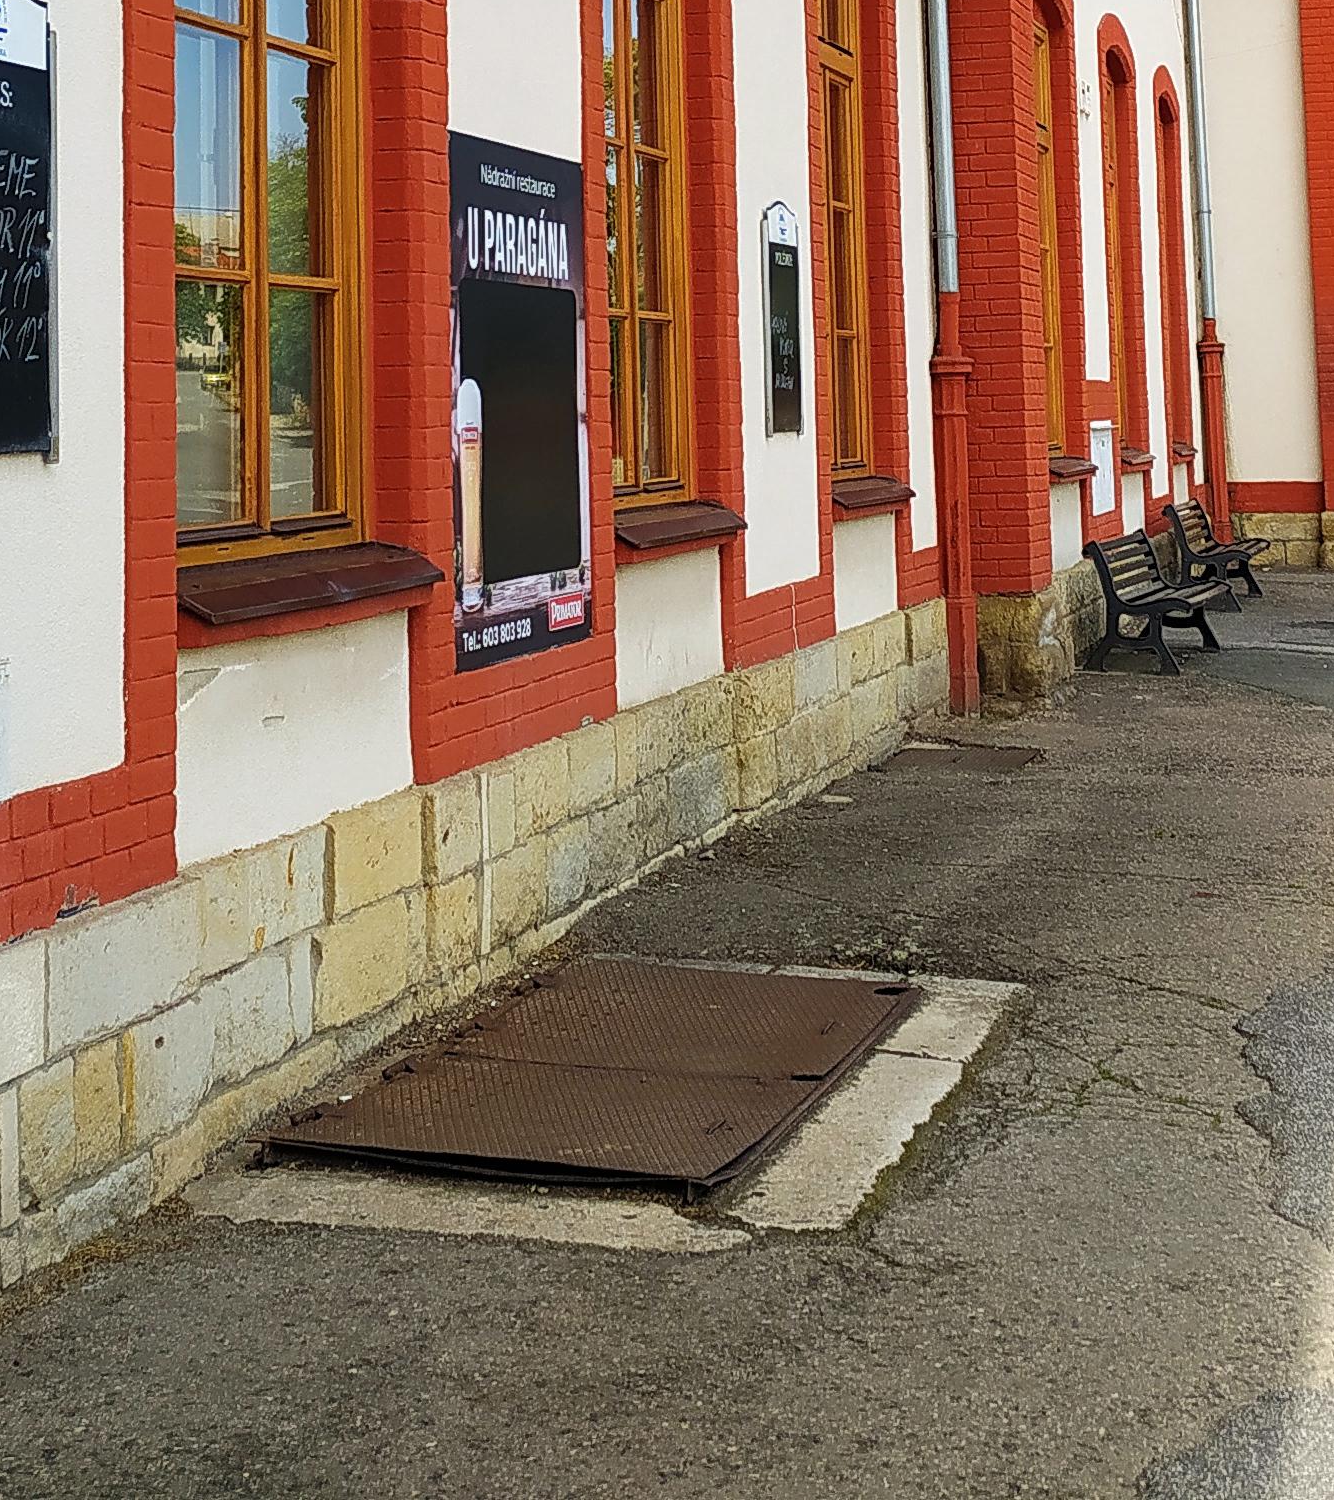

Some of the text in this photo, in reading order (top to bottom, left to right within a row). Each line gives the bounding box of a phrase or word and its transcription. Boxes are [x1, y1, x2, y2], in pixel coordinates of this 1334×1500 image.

[480, 163, 556, 198] Nádražní restaurace
[467, 206, 569, 280] U PARAGÁNA
[462, 617, 532, 652] Tel.: 603 803 928
